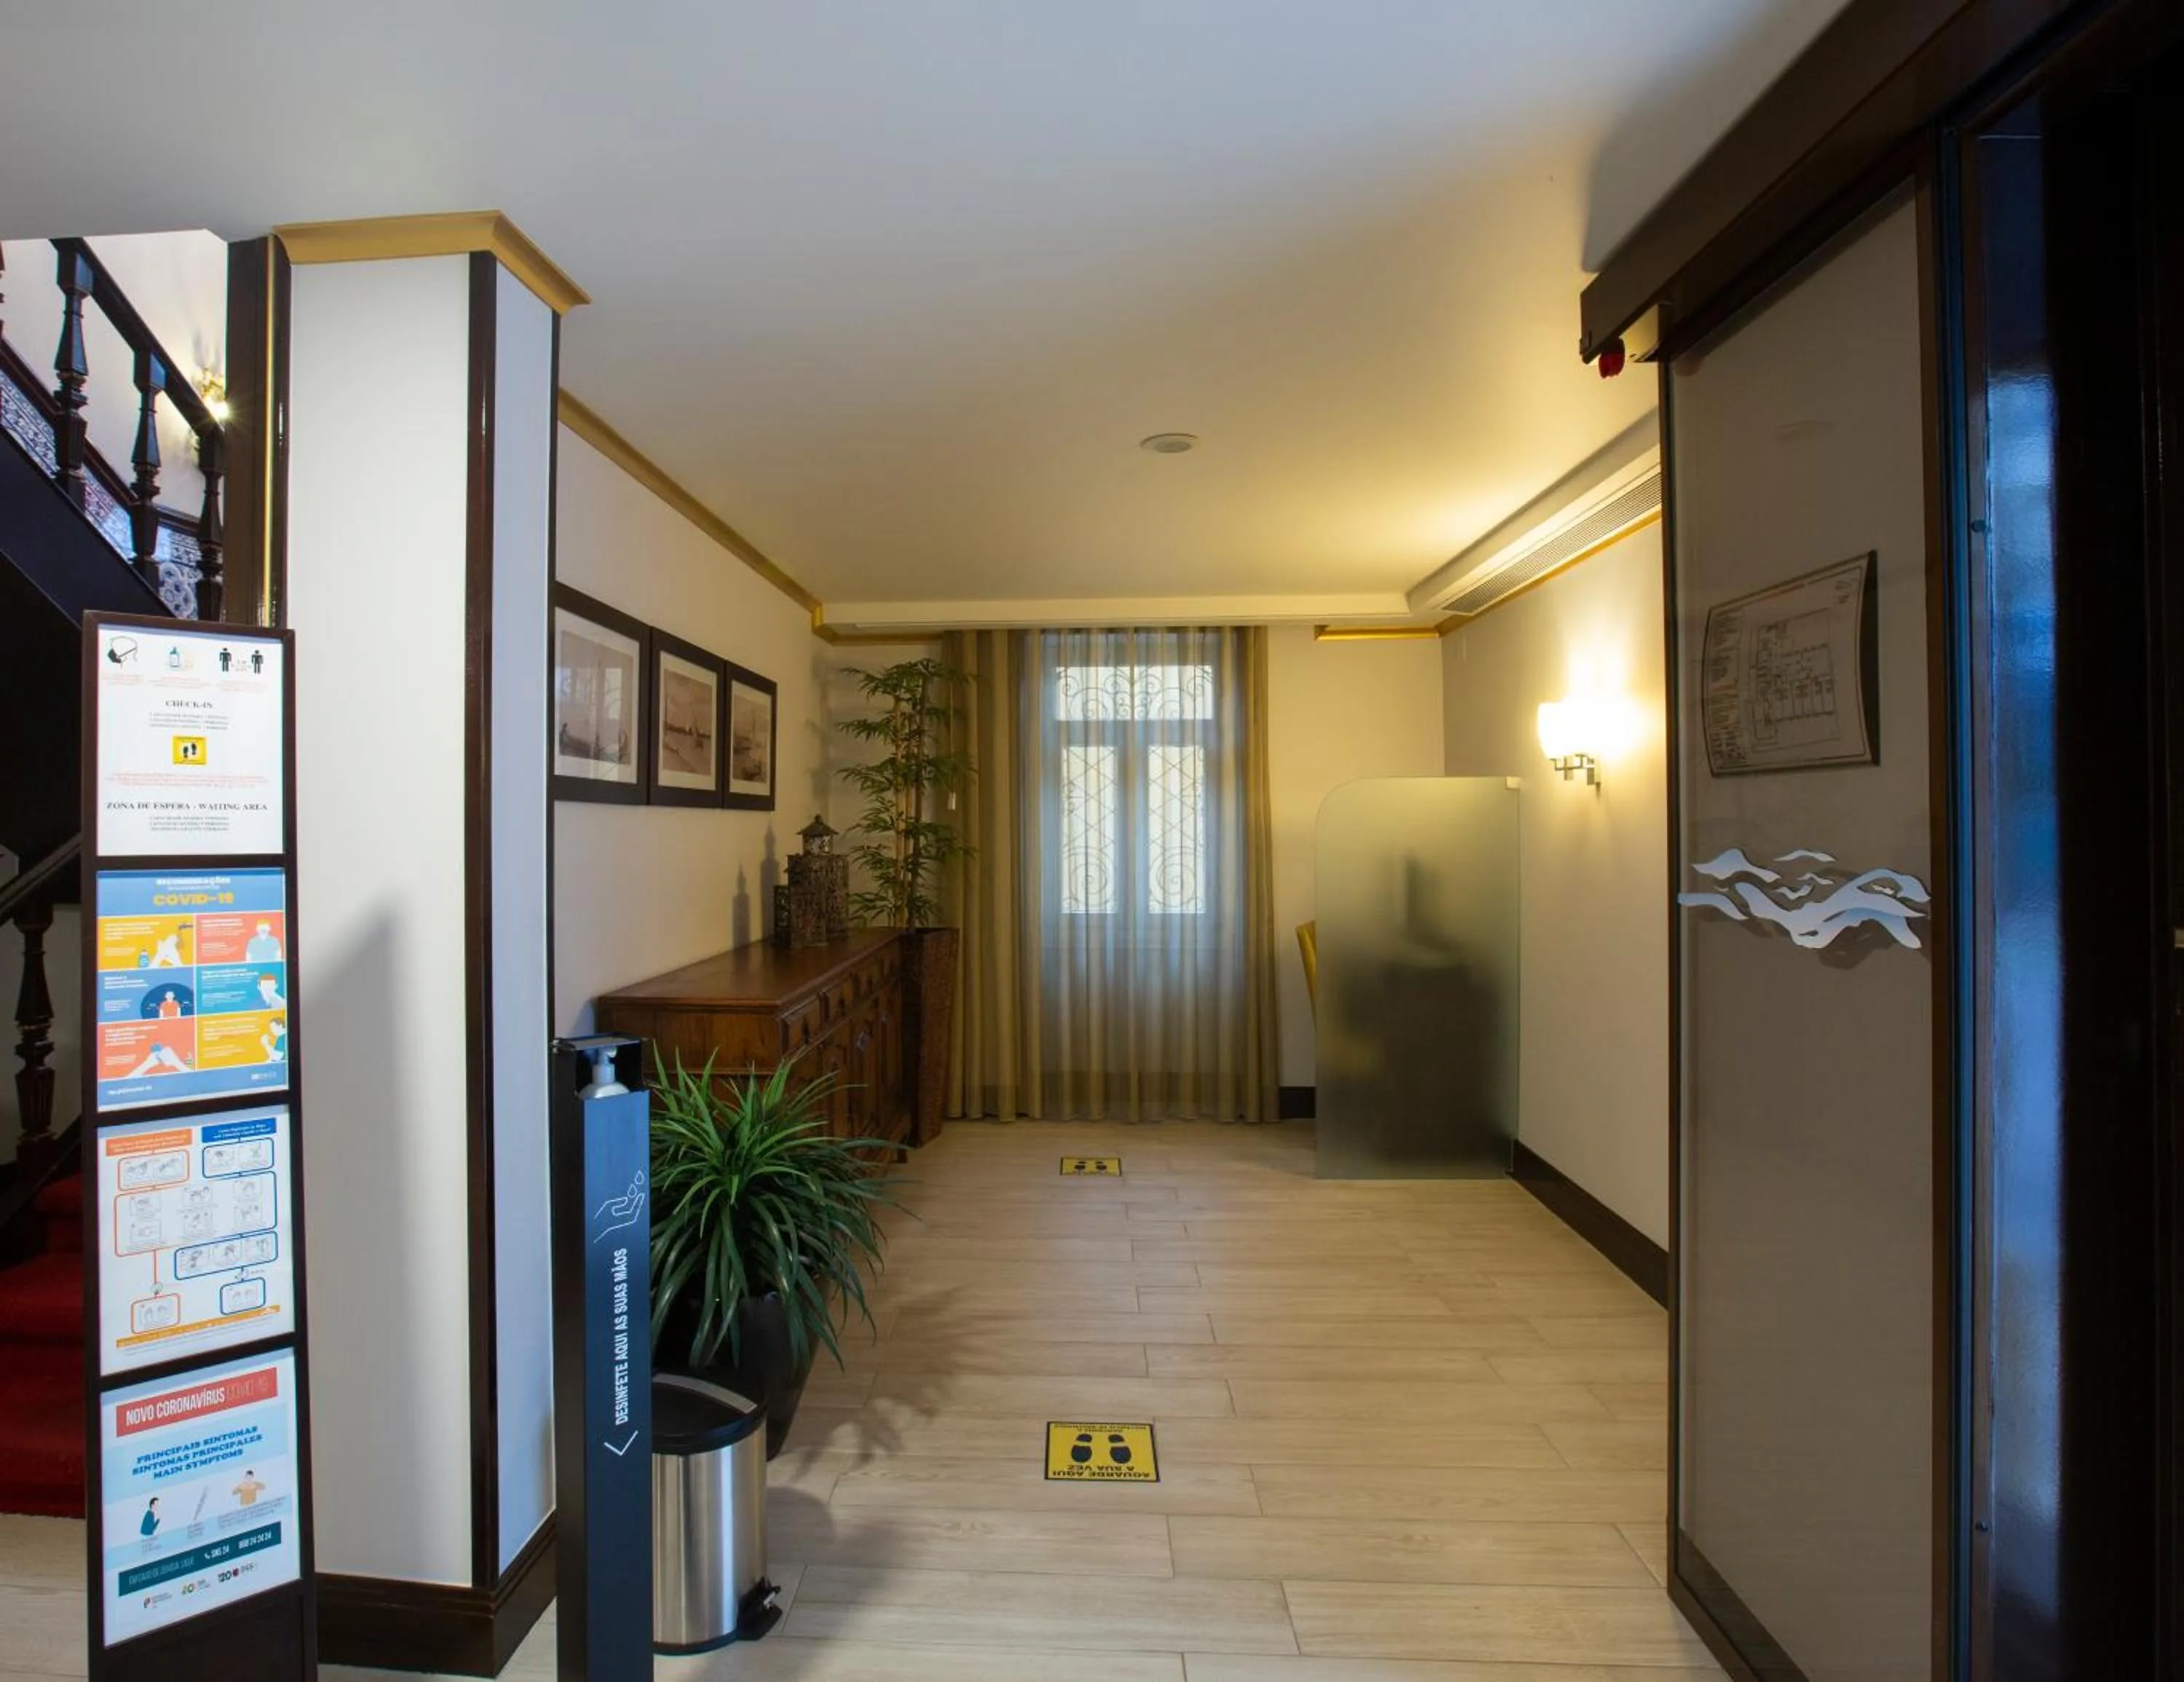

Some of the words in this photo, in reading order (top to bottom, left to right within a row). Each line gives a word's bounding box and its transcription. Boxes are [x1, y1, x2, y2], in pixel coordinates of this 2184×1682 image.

[165, 700, 213, 708] CHECK-IN
[107, 802, 134, 810] ZONA
[154, 802, 190, 810] ESPERA
[153, 892, 234, 906] COVID-19
[612, 1247, 628, 1282] MÃOS
[614, 1284, 628, 1314] SUAS
[614, 1315, 628, 1330] AS
[614, 1332, 628, 1360] AQUI
[126, 1405, 154, 1426] NOVO
[156, 1386, 225, 1418] CORONAVÍRUS
[614, 1362, 629, 1426] DESINFETE
[132, 1454, 190, 1475] SINTOMAS
[192, 1434, 263, 1459] PRINCIPALES
[137, 1441, 201, 1464] PRINCIPAIS
[203, 1426, 258, 1448] SINTOMAS
[154, 1465, 183, 1480] MAIN
[184, 1448, 244, 1471] SYMPTOMS
[1052, 1469, 1085, 1477] AQUI
